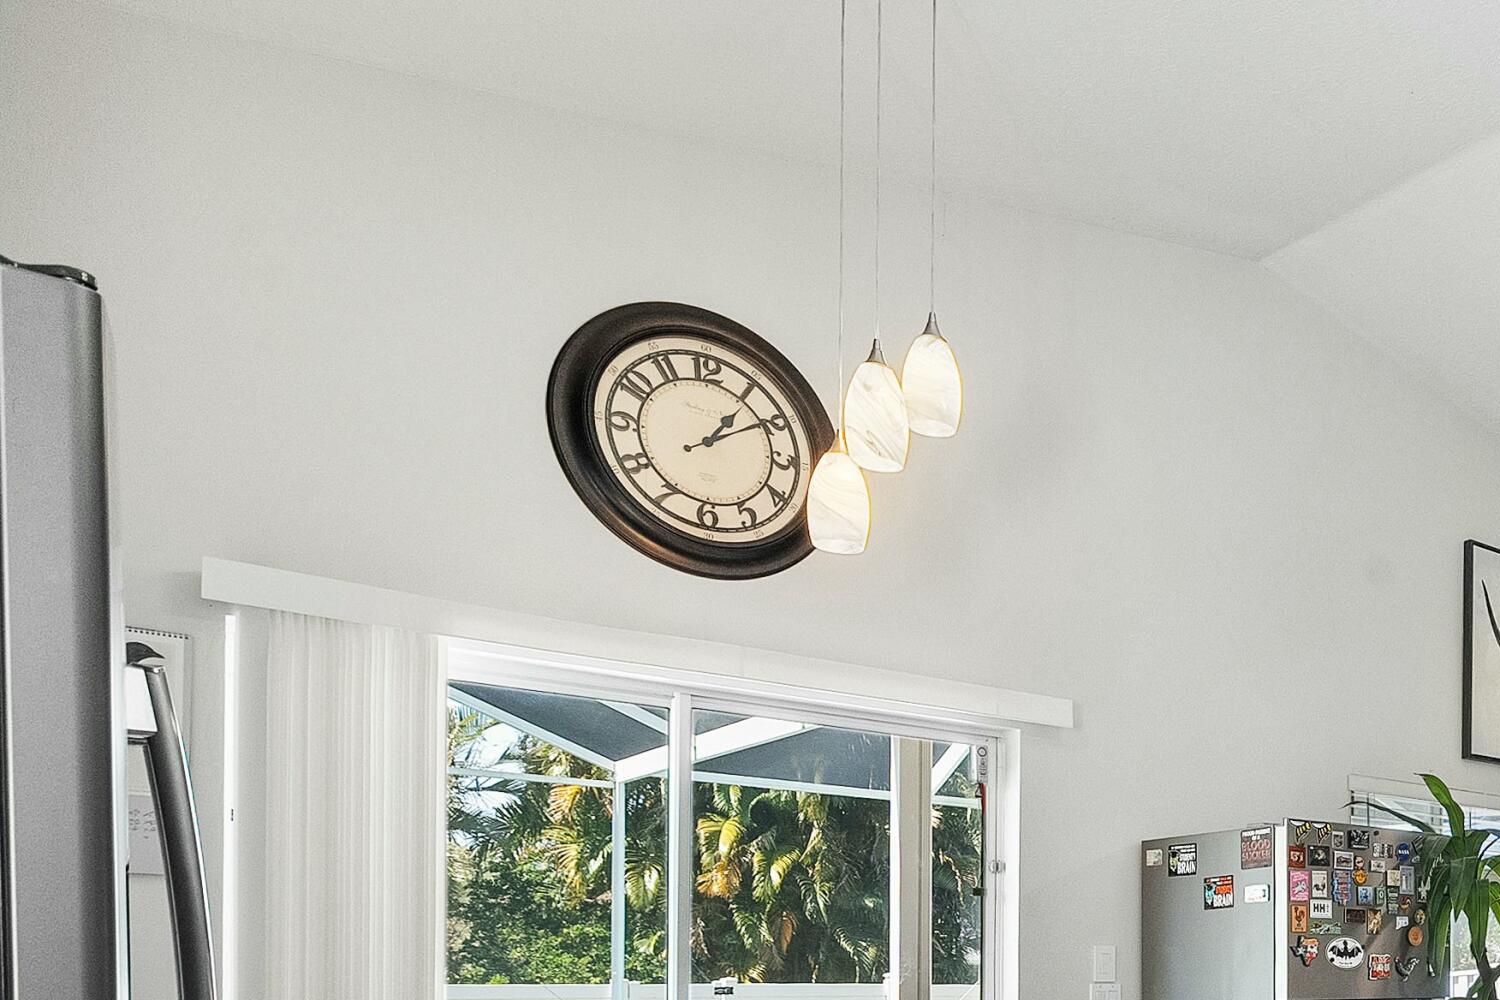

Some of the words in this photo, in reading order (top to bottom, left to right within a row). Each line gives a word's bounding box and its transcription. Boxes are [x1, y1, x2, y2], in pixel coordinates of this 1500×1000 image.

[701, 345, 712, 353] 60
[651, 353, 680, 383] 11
[691, 353, 724, 385] 12
[620, 369, 654, 402] 10
[739, 382, 756, 402] 1
[610, 411, 640, 432] 9
[759, 414, 788, 436] 2
[620, 452, 652, 475] 8
[772, 451, 799, 471] 3
[652, 483, 683, 506] 7
[764, 482, 790, 509] 4
[696, 502, 719, 529] 6
[737, 500, 758, 529] 5
[1242, 839, 1270, 852] BLOOD
[1176, 860, 1196, 875] BRAIN
[1213, 892, 1234, 908] BRAIN
[1313, 903, 1326, 913] HH
